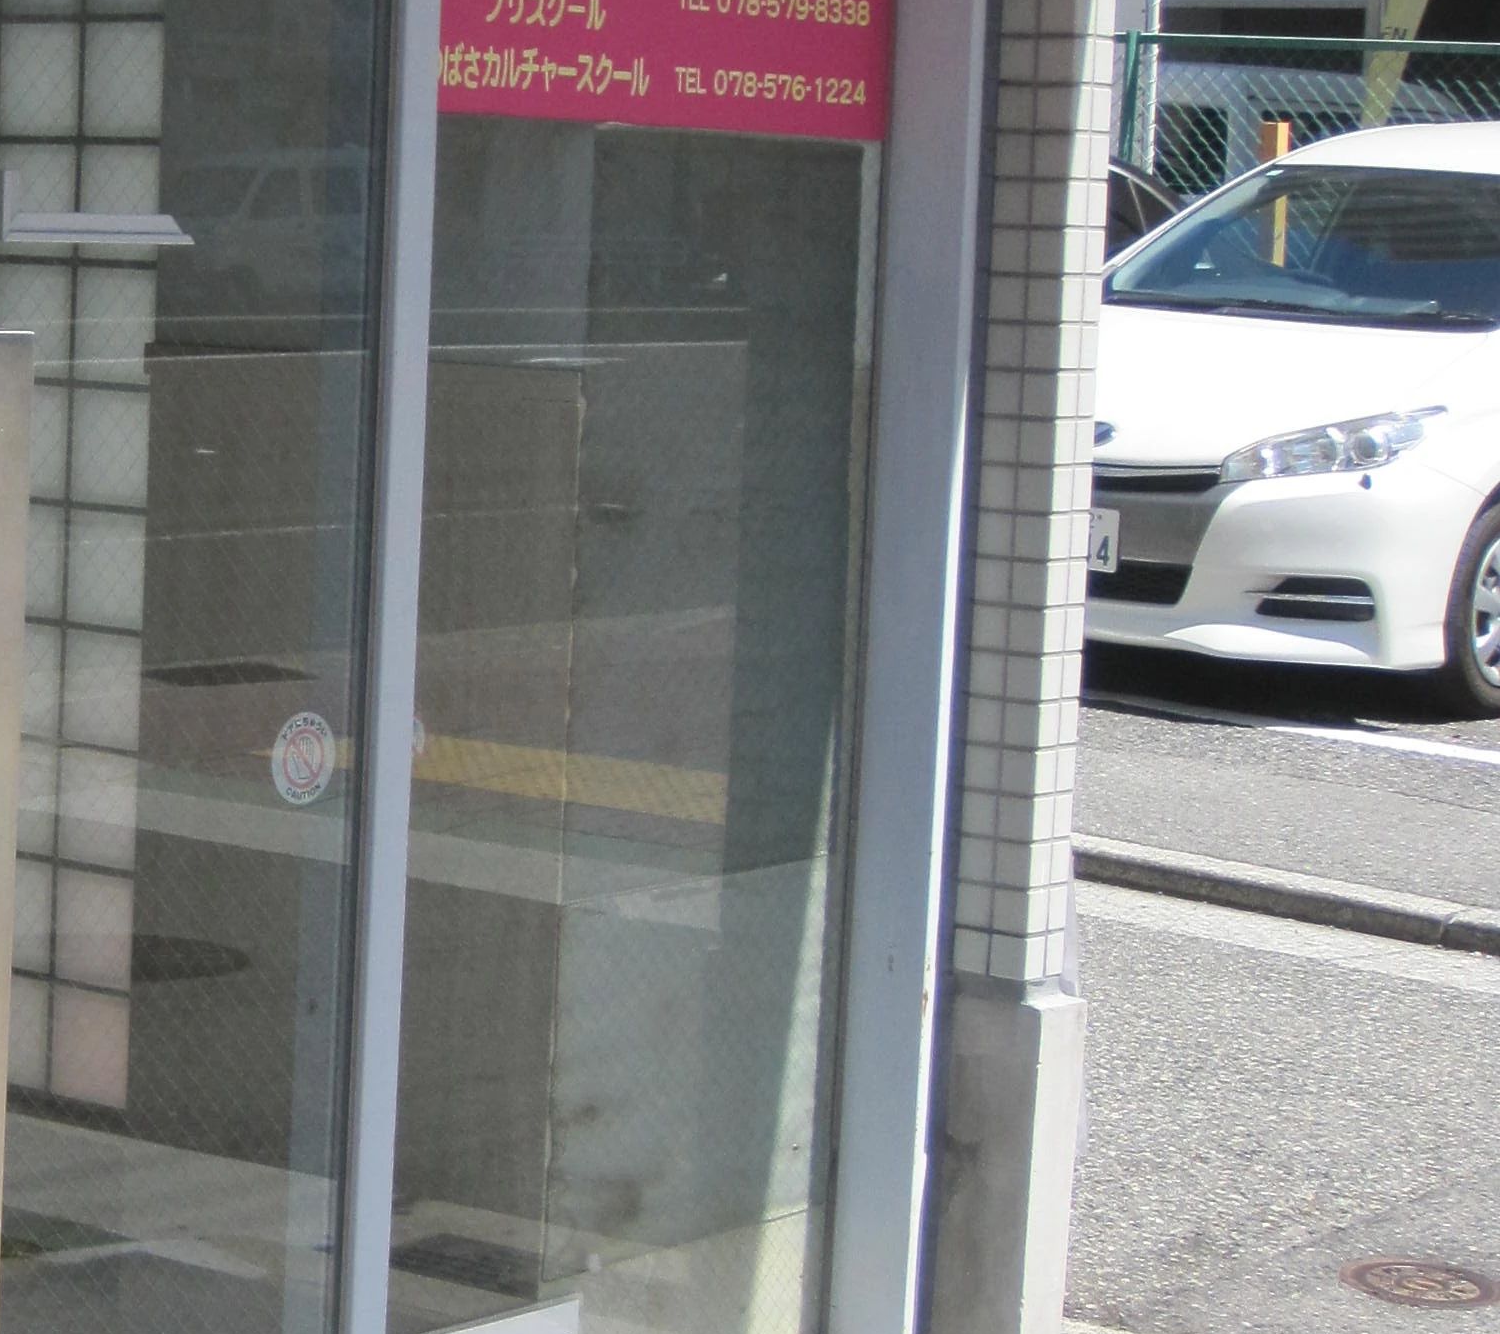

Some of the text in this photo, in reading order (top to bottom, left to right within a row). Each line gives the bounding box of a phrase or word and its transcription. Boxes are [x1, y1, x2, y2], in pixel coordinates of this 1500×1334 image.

[437, 40, 650, 97] ばさカルチャースクール
[674, 65, 707, 95] TEL
[286, 783, 322, 800] CAUTION
